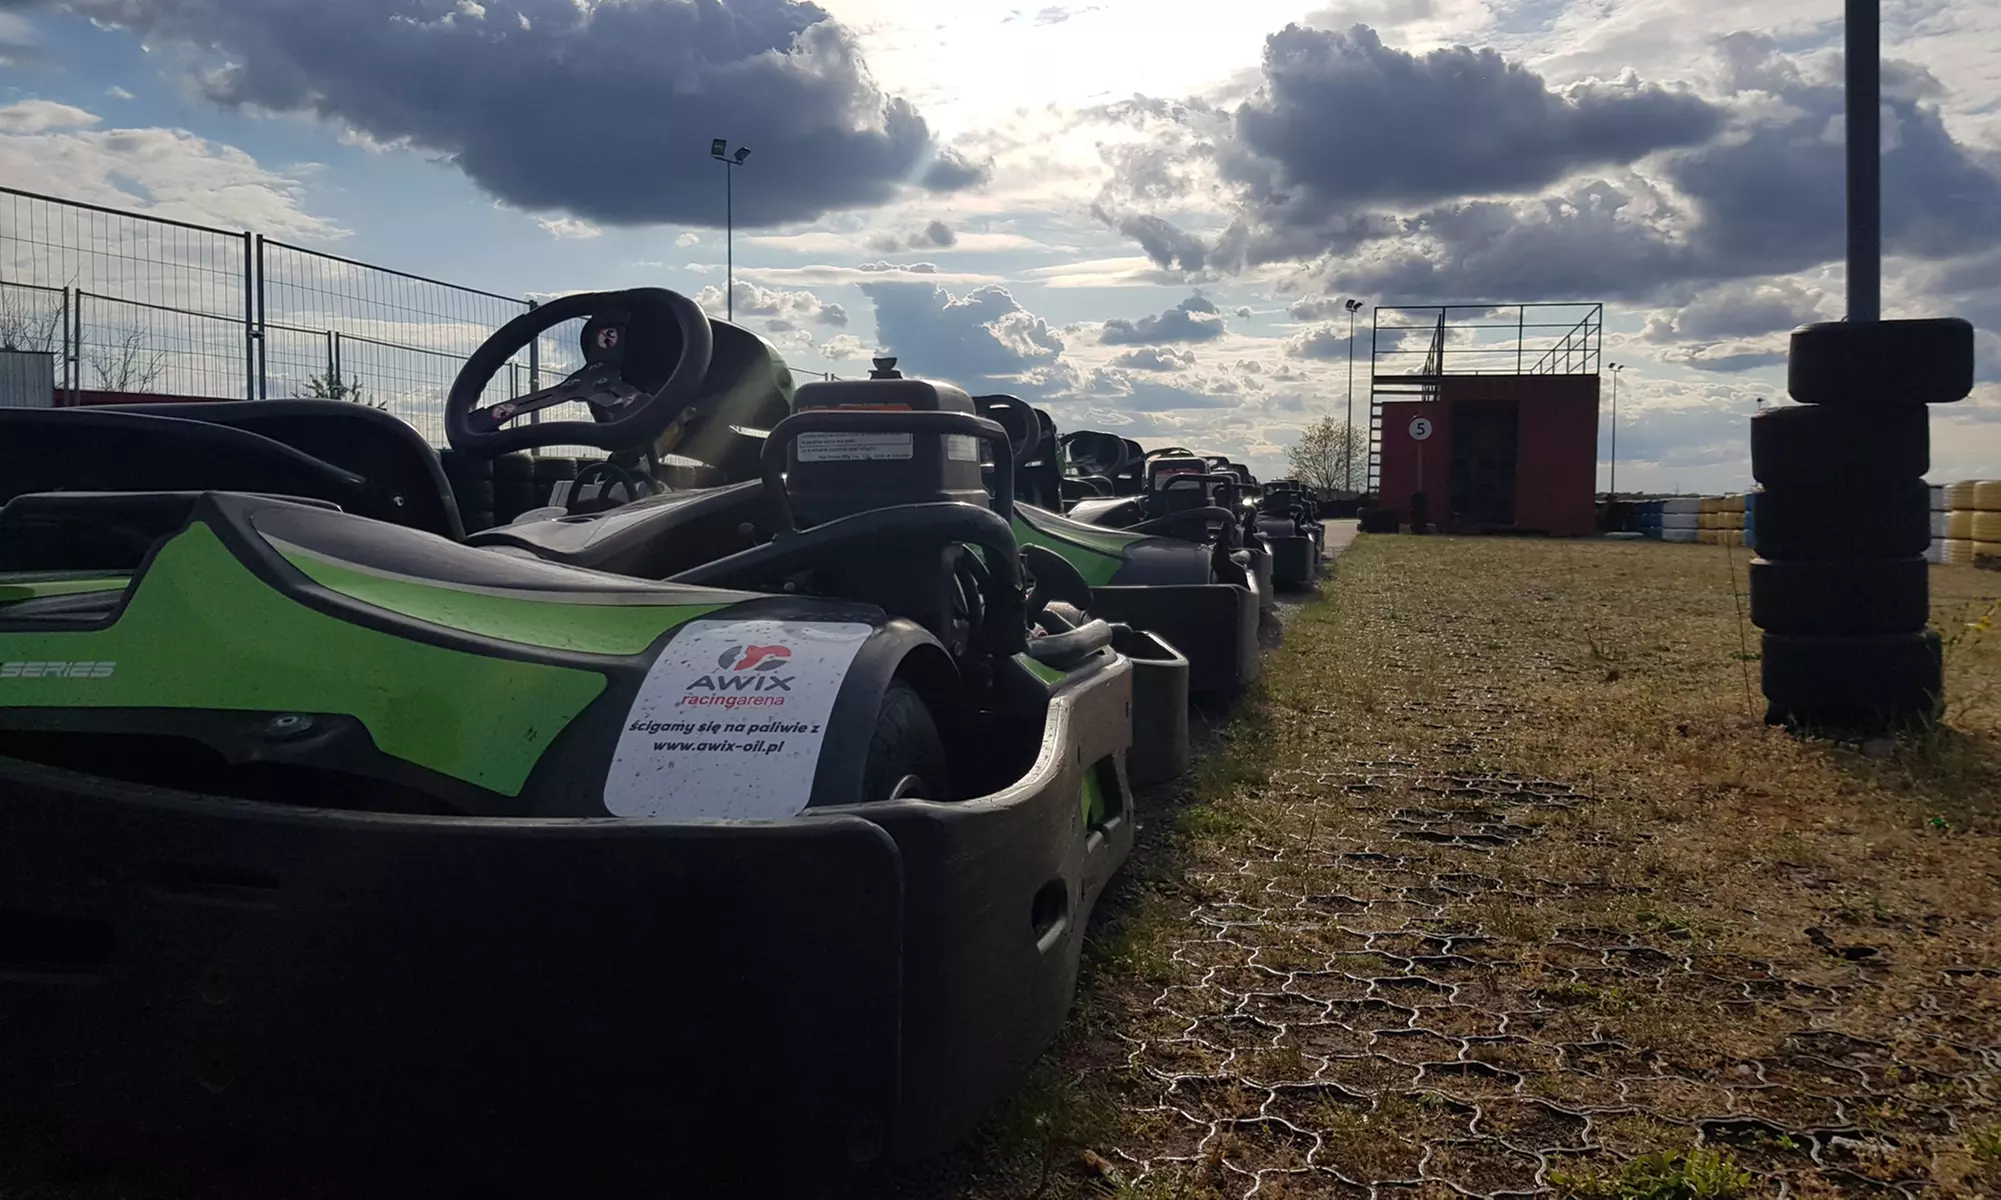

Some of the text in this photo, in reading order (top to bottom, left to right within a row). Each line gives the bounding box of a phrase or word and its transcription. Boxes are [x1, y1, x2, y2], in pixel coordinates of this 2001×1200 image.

[1416, 422, 1426, 436] 5
[686, 675, 796, 691] AWIX
[681, 695, 785, 708] racingarena
[629, 720, 821, 734] ścigamy się na paliwie z
[653, 740, 784, 755] www.awix-oil.pl
